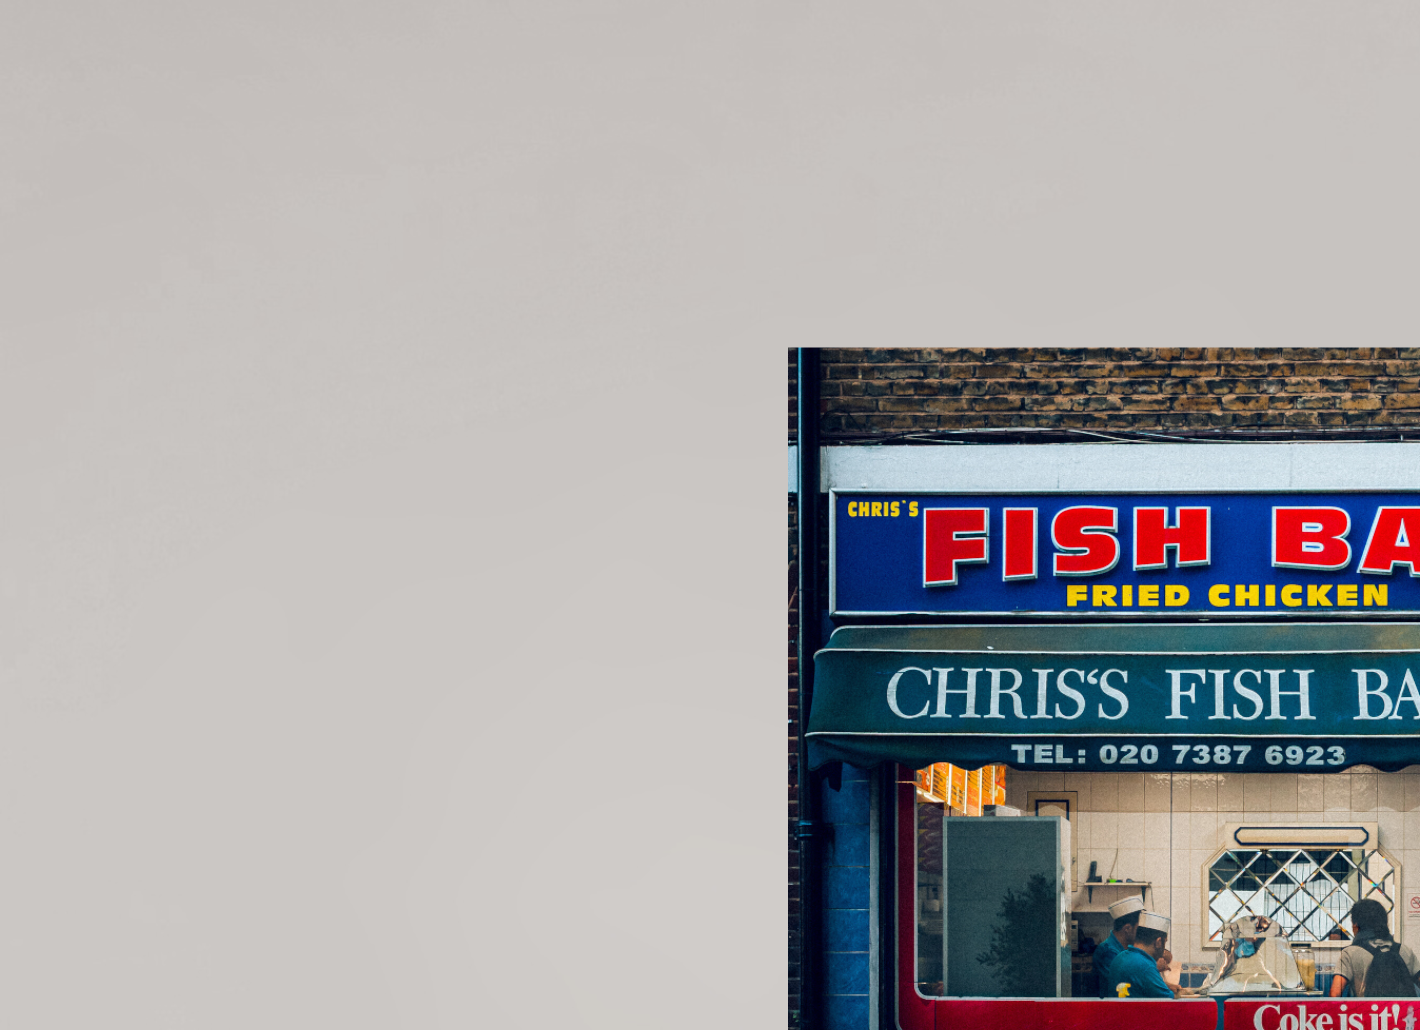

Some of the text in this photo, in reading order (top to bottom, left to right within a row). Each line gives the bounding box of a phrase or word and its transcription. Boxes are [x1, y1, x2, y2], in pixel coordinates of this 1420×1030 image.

[847, 500, 919, 518] CHRIS'S
[922, 505, 1212, 588] FISH
[1066, 583, 1389, 608] FRIED CHICKEN
[886, 666, 1130, 720] CHRIS'S
[1164, 668, 1317, 721] FISH
[1010, 744, 1347, 766] TEL: 020 7387 6923
